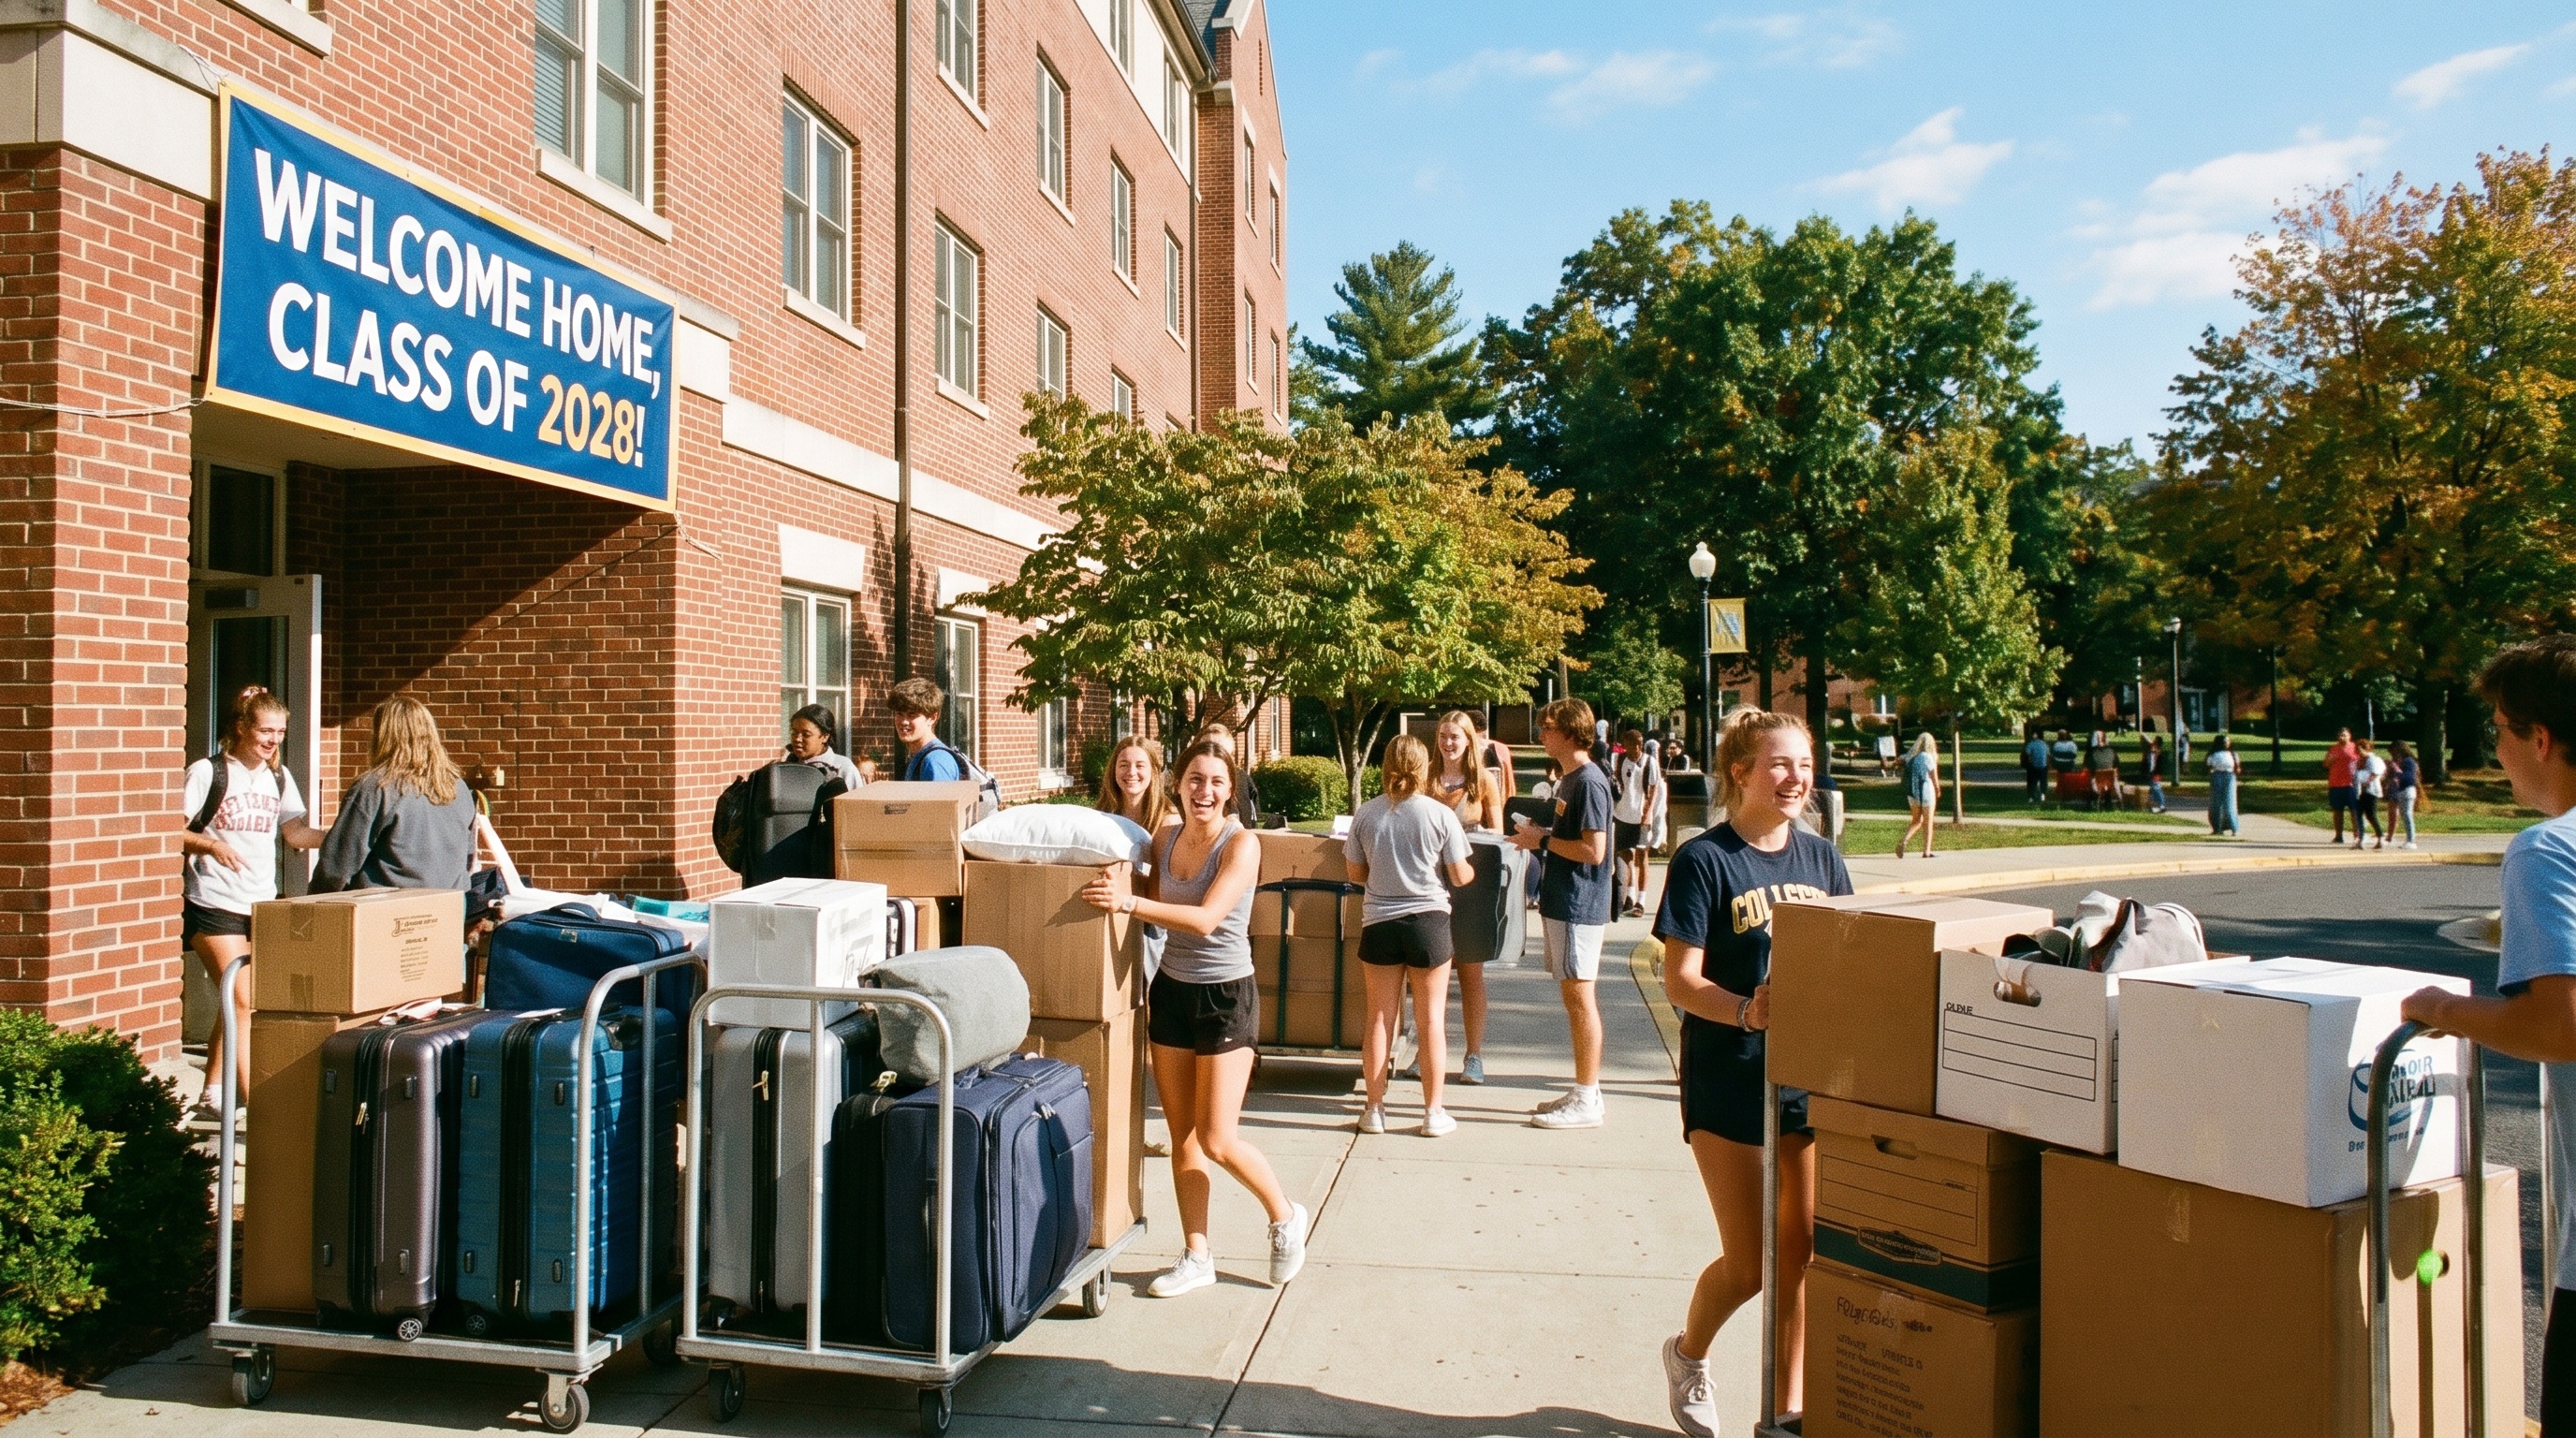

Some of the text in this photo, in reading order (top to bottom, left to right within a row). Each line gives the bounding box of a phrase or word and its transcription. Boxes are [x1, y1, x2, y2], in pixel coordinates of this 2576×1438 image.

[254, 147, 661, 400] WELCOME HOME,
[269, 282, 646, 468] CLASS OF 2028!
